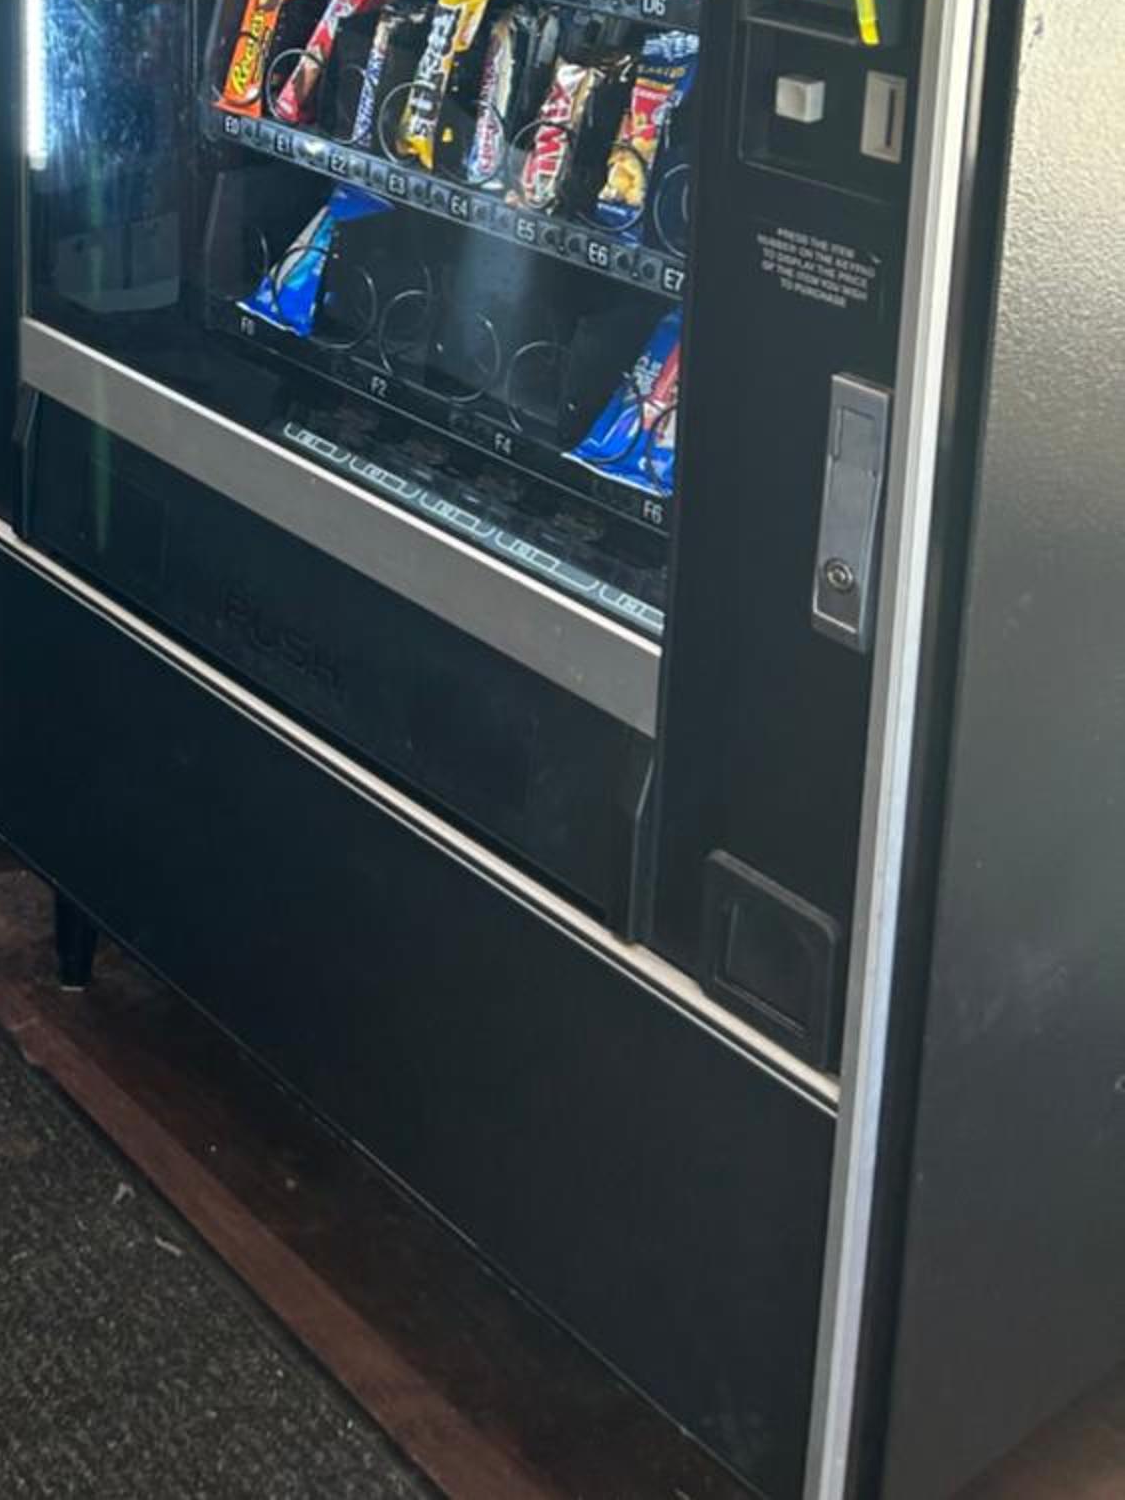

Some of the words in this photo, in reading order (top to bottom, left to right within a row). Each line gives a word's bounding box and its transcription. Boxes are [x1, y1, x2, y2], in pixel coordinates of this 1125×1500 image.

[331, 155, 348, 174] E2
[388, 174, 406, 195] E3
[450, 195, 469, 216] E4
[517, 218, 536, 241] E5
[589, 243, 608, 266] E6
[664, 269, 684, 293] E7
[371, 376, 387, 396] F2
[494, 433, 512, 454] F4
[643, 500, 662, 524] F6
